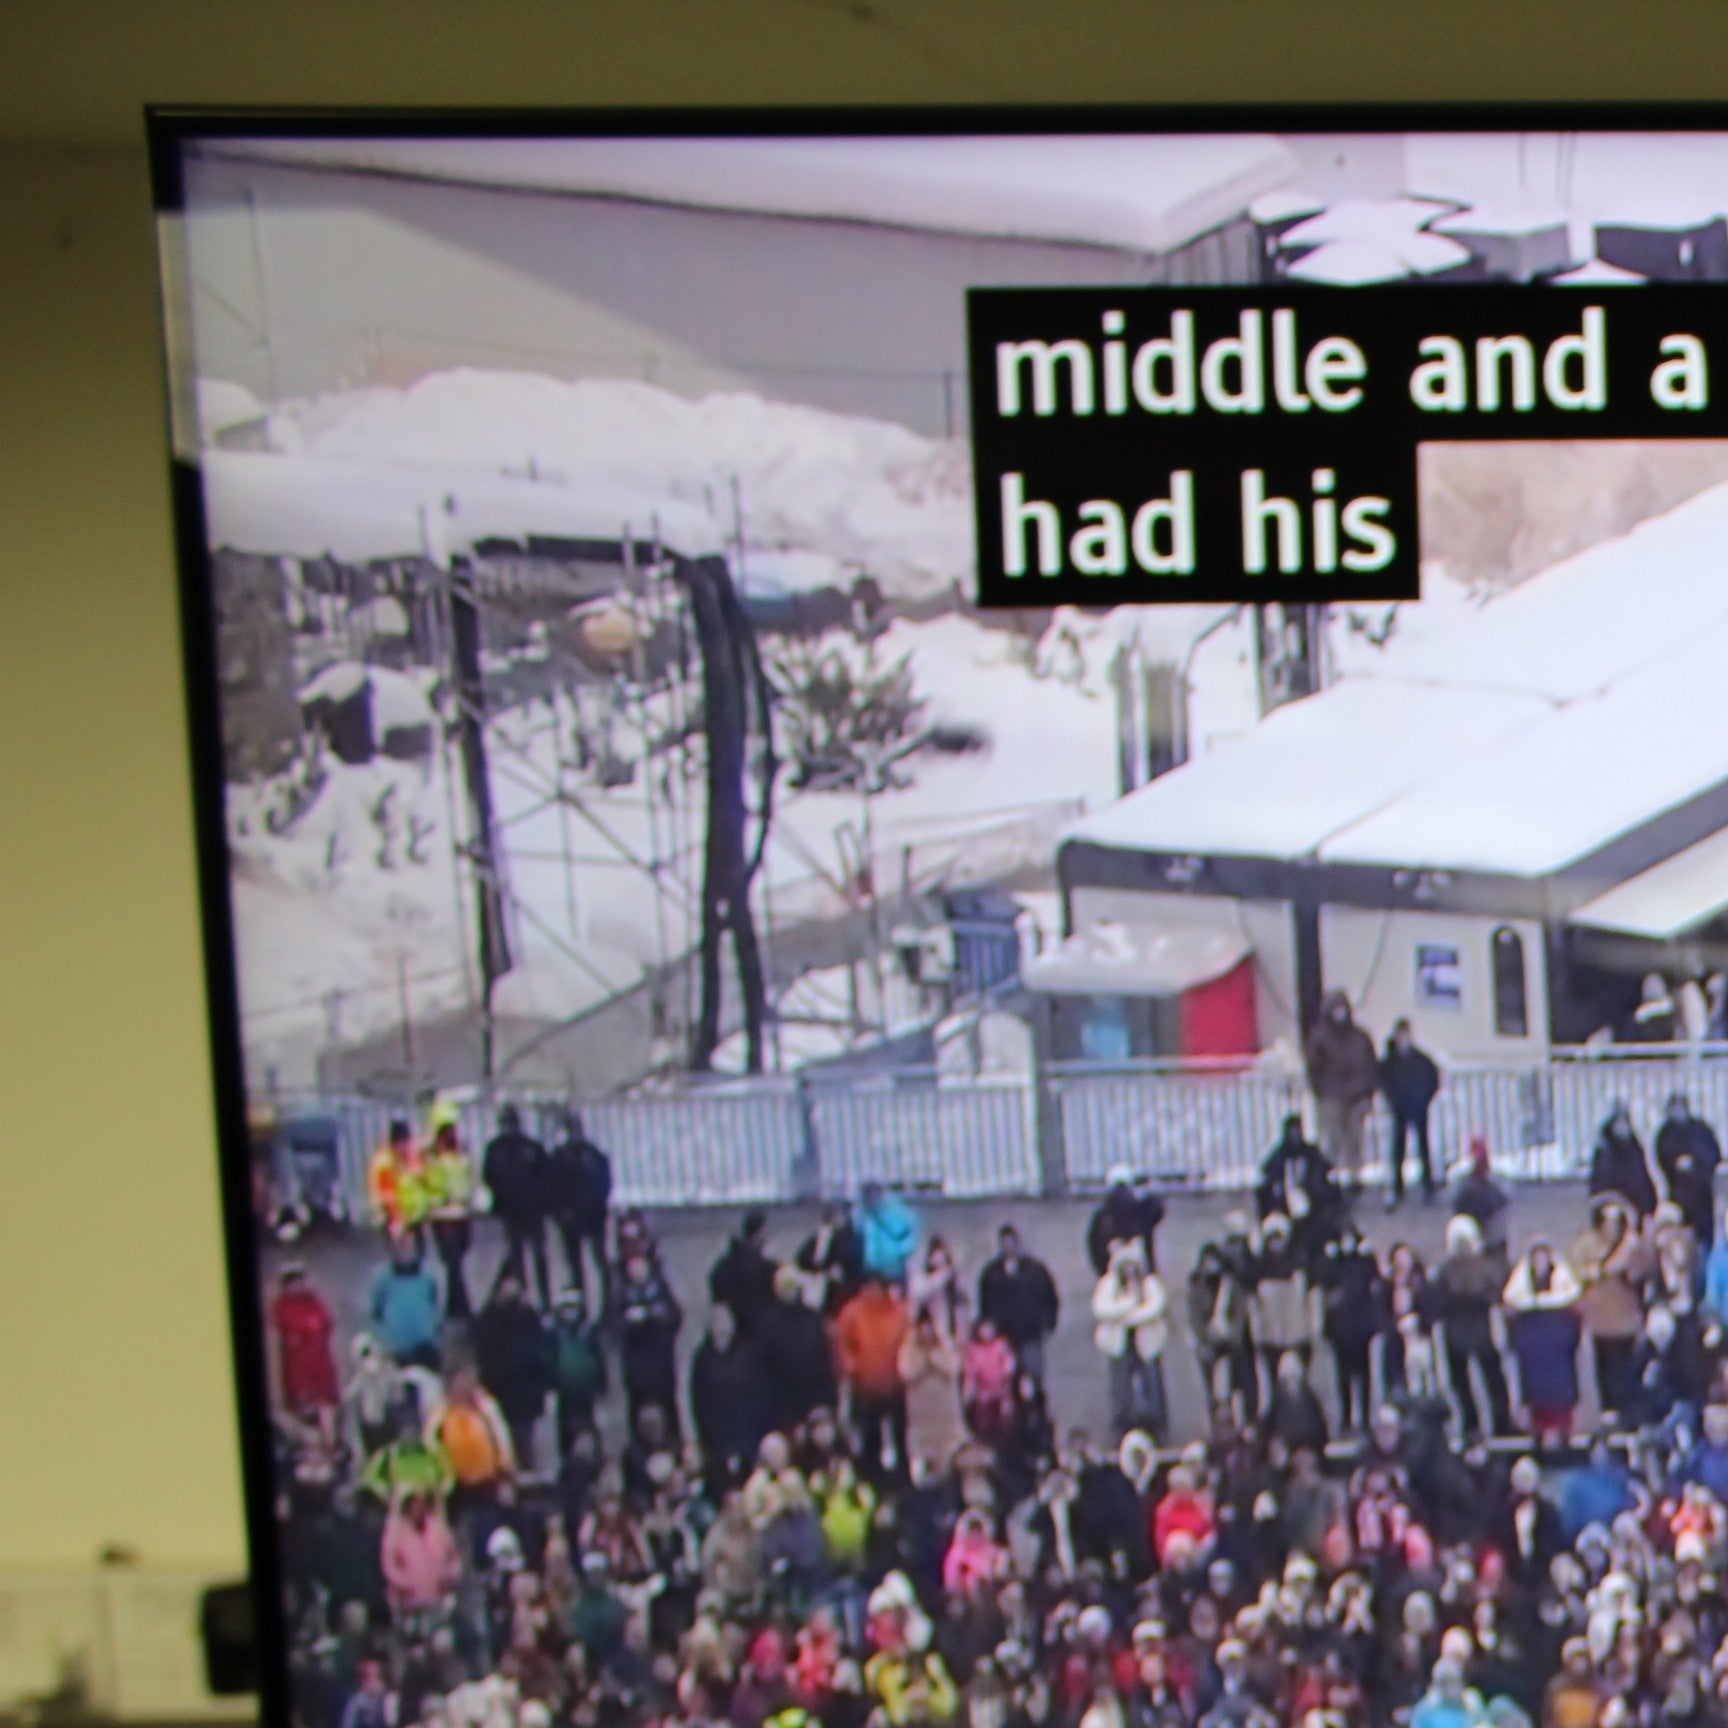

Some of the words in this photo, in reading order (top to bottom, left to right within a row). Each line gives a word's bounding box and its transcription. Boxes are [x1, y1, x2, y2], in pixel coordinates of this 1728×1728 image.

[995, 307, 1367, 416] middle
[1408, 305, 1606, 412] and
[1649, 333, 1708, 410] a
[1000, 469, 1195, 577] had
[1240, 467, 1396, 574] his
